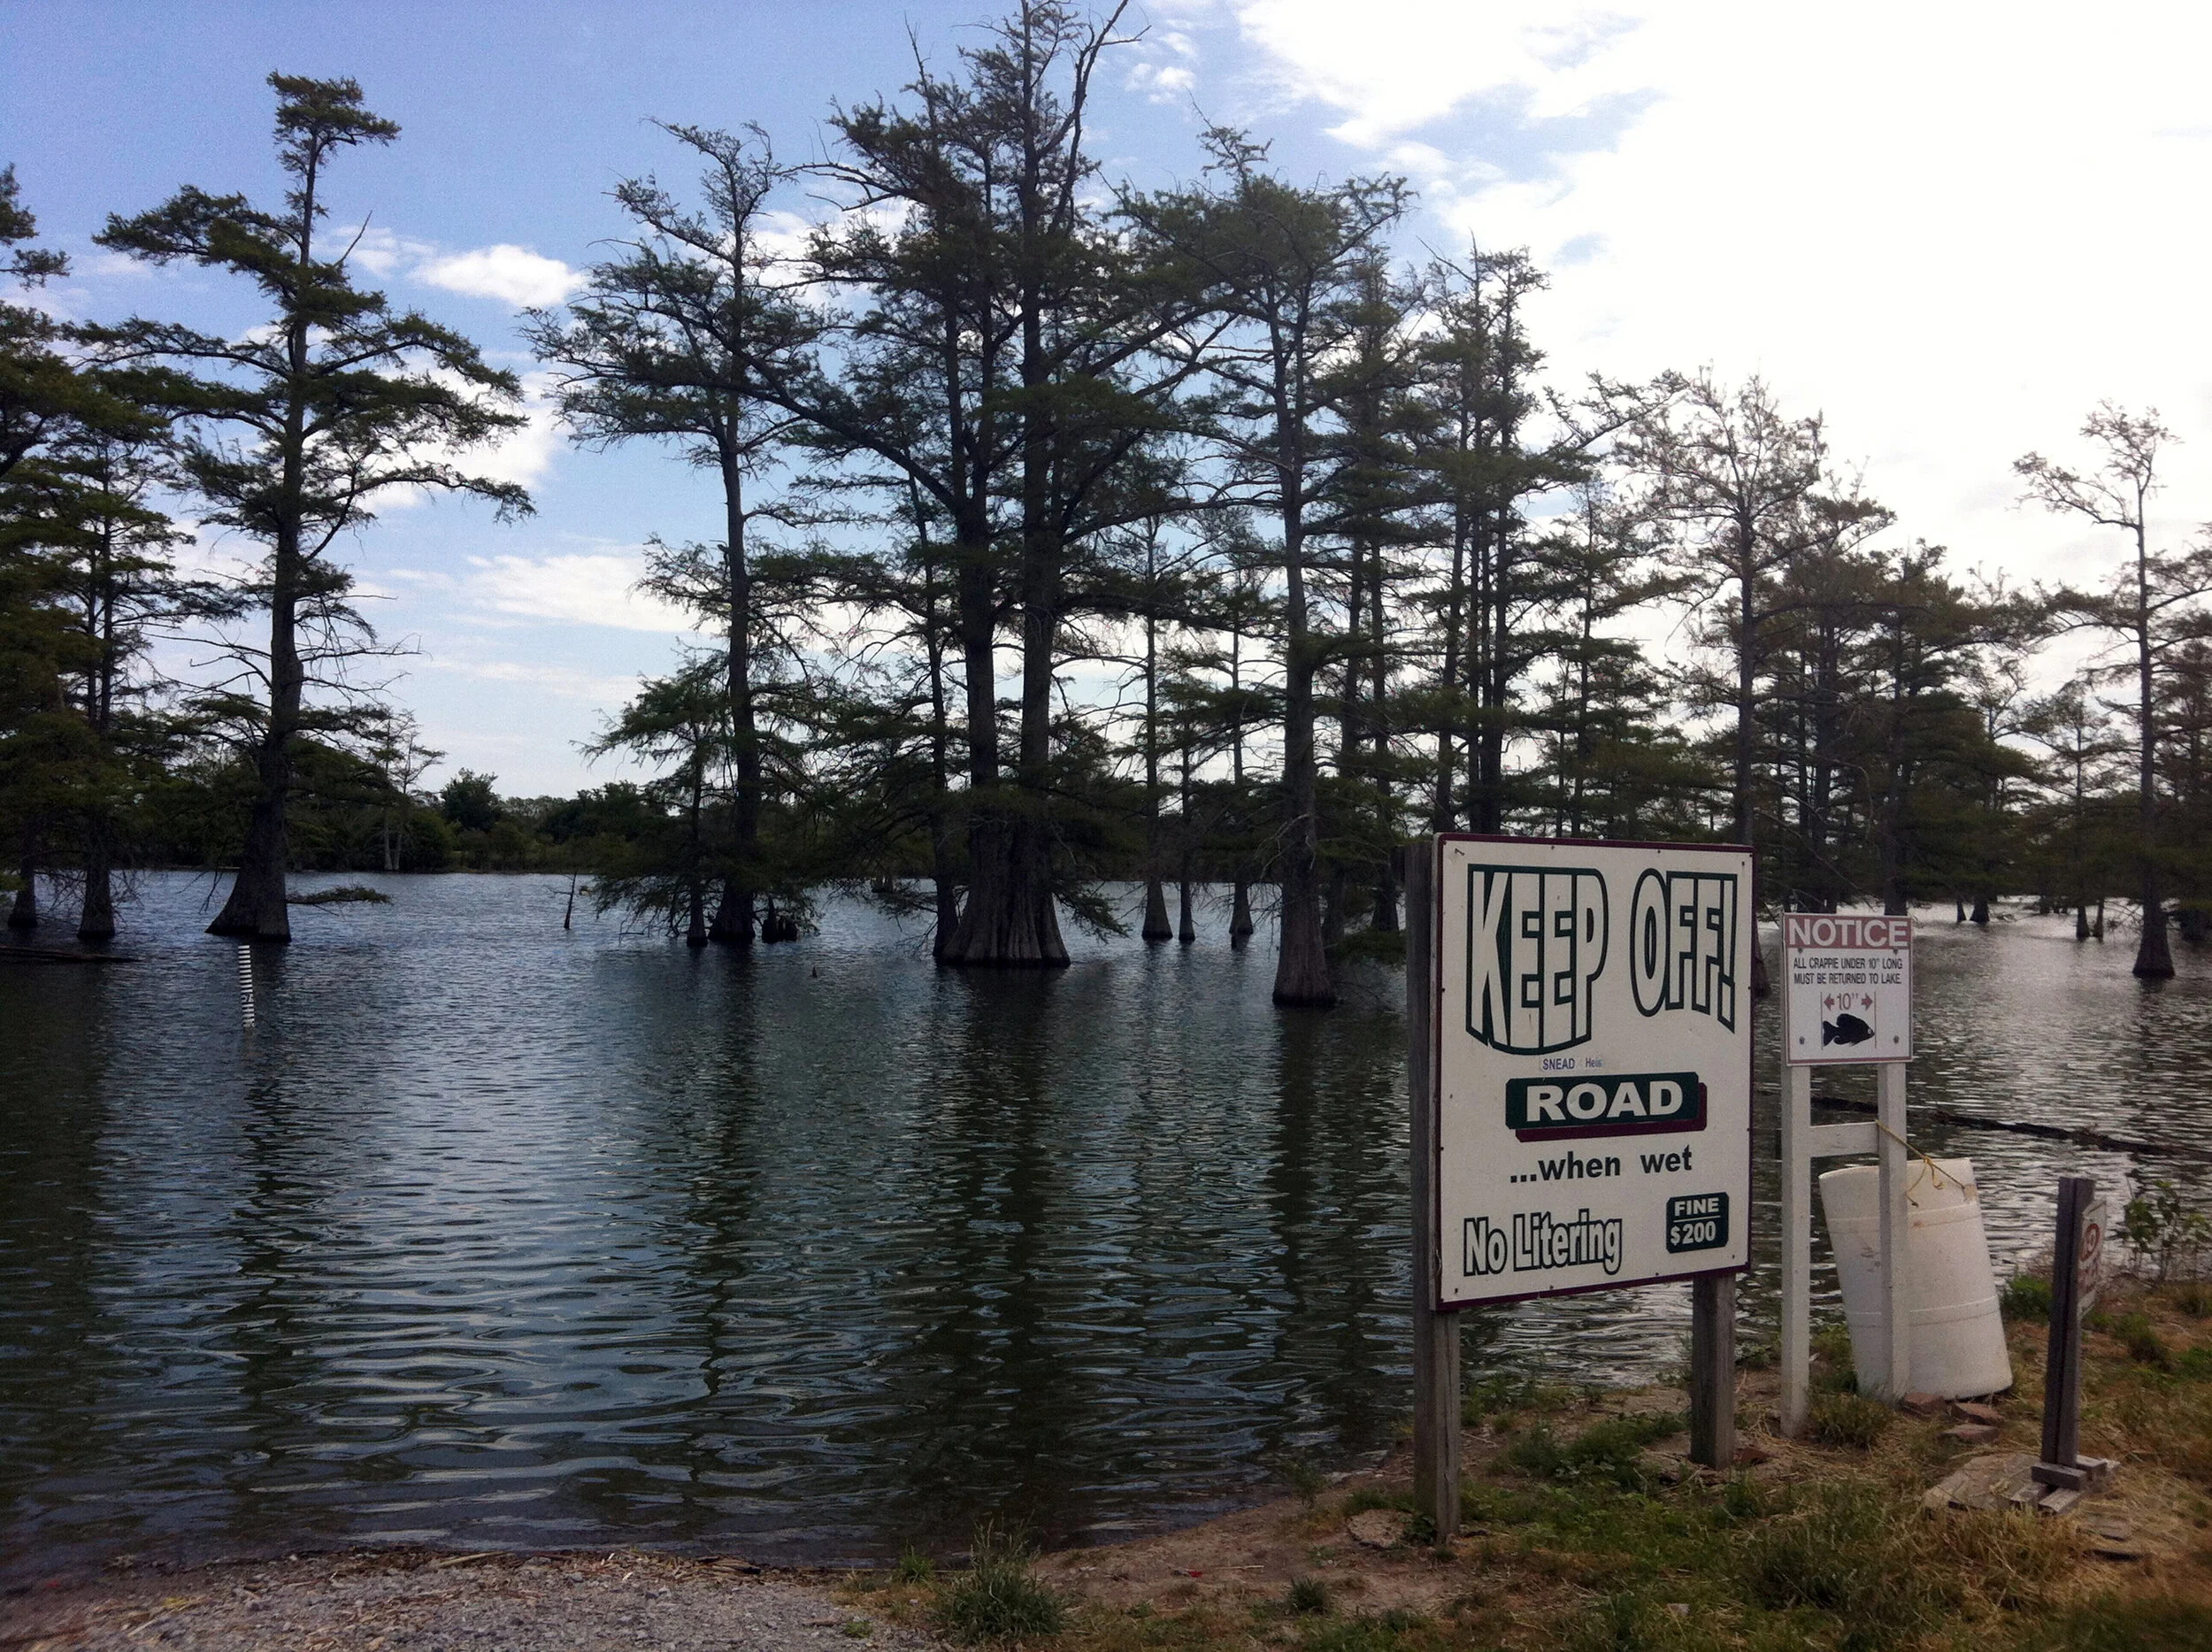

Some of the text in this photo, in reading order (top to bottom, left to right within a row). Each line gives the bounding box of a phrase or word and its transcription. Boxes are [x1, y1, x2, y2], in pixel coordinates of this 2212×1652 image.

[1788, 918, 1909, 947] NOTICE
[1466, 864, 1738, 1055] KEEP OFF!
[1793, 957, 1807, 969] ALL
[1809, 957, 1839, 969] CRAPPIE
[1840, 957, 1865, 969] UNDER
[1883, 958, 1902, 970] LONG
[1794, 973, 1814, 984] MUST
[1817, 973, 1826, 984] BE
[1829, 973, 1866, 984] RETURNED
[1869, 973, 1879, 984] TO
[1542, 1058, 1575, 1071] SNEAD
[1525, 1080, 1683, 1122] ROAD
[1509, 1145, 1692, 1183] ...when wet
[1674, 1197, 1719, 1217] FINE
[1463, 1208, 1623, 1277] No Litering
[1670, 1221, 1717, 1246] $200
